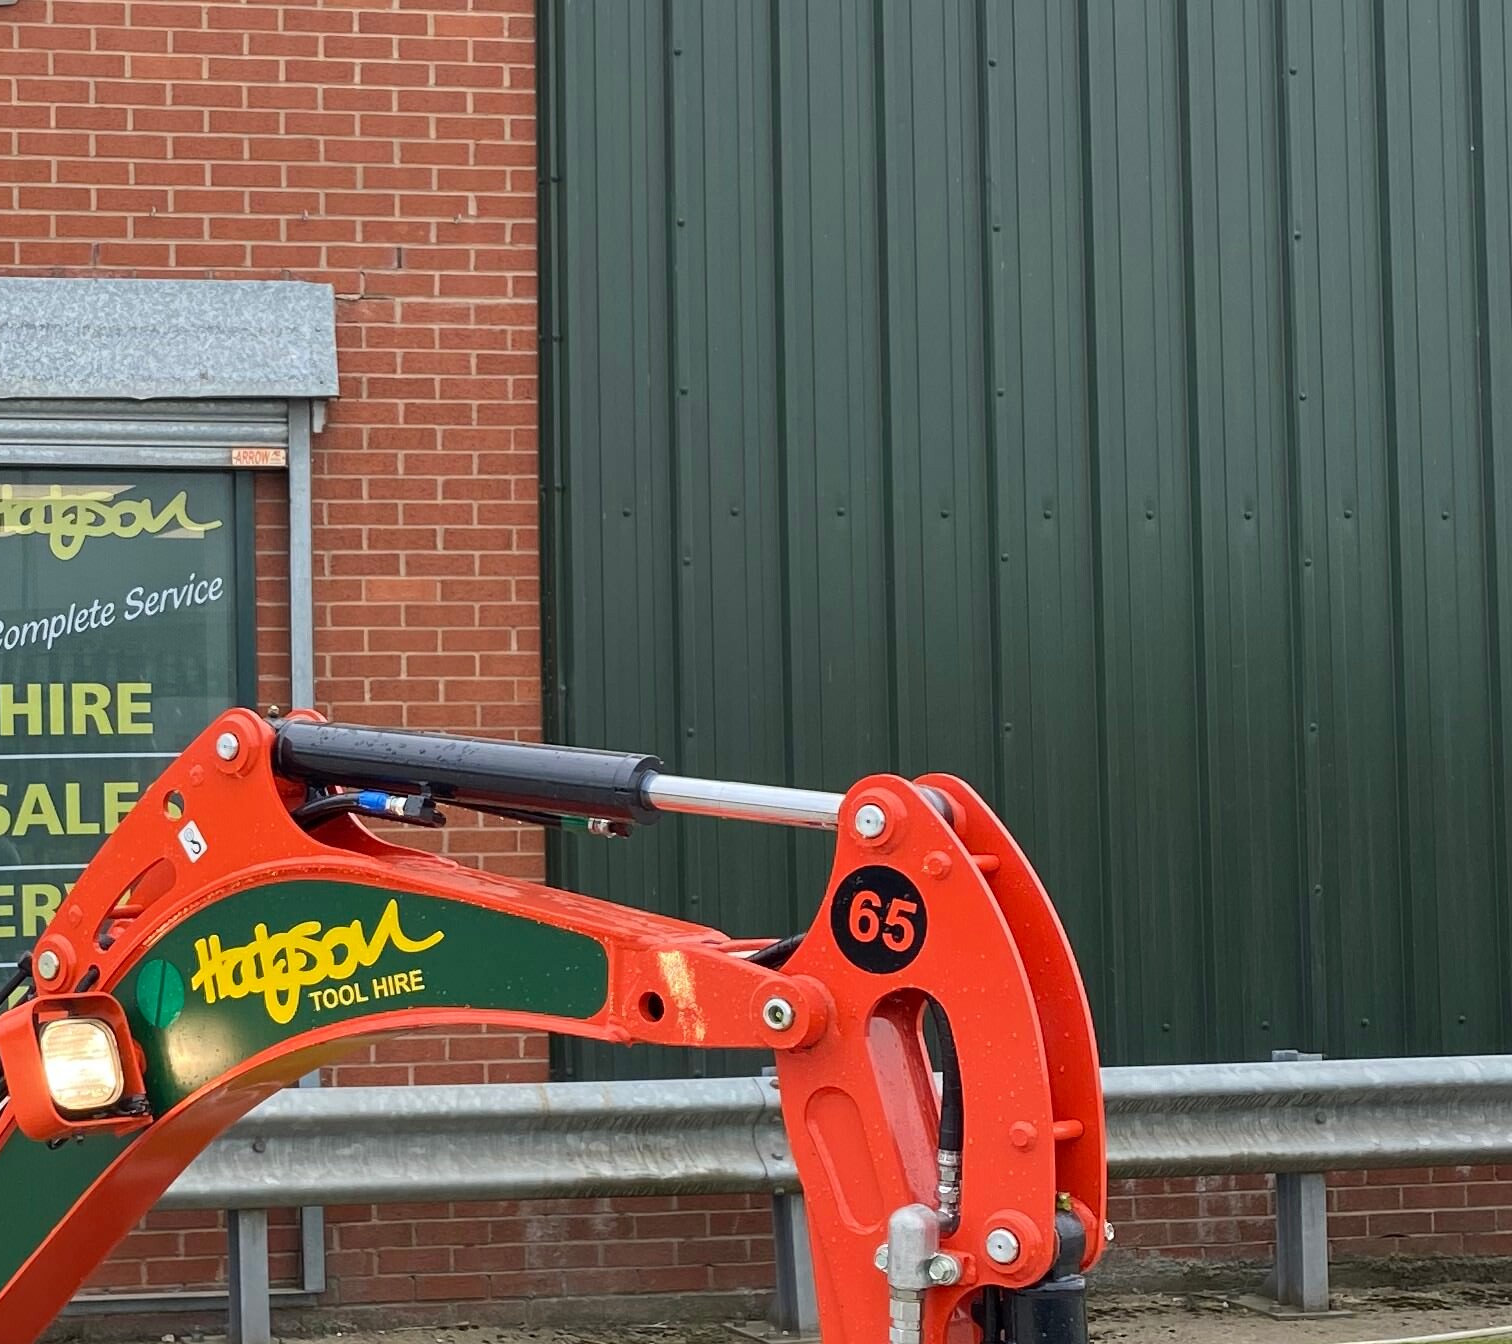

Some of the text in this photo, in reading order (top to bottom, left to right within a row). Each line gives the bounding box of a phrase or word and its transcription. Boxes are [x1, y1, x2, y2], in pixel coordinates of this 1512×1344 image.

[124, 573, 224, 621] Service
[0, 682, 153, 736] HIRE
[849, 890, 918, 952] 65
[191, 899, 445, 1024] Hodgson
[308, 969, 426, 1012] TOOL HIRE
